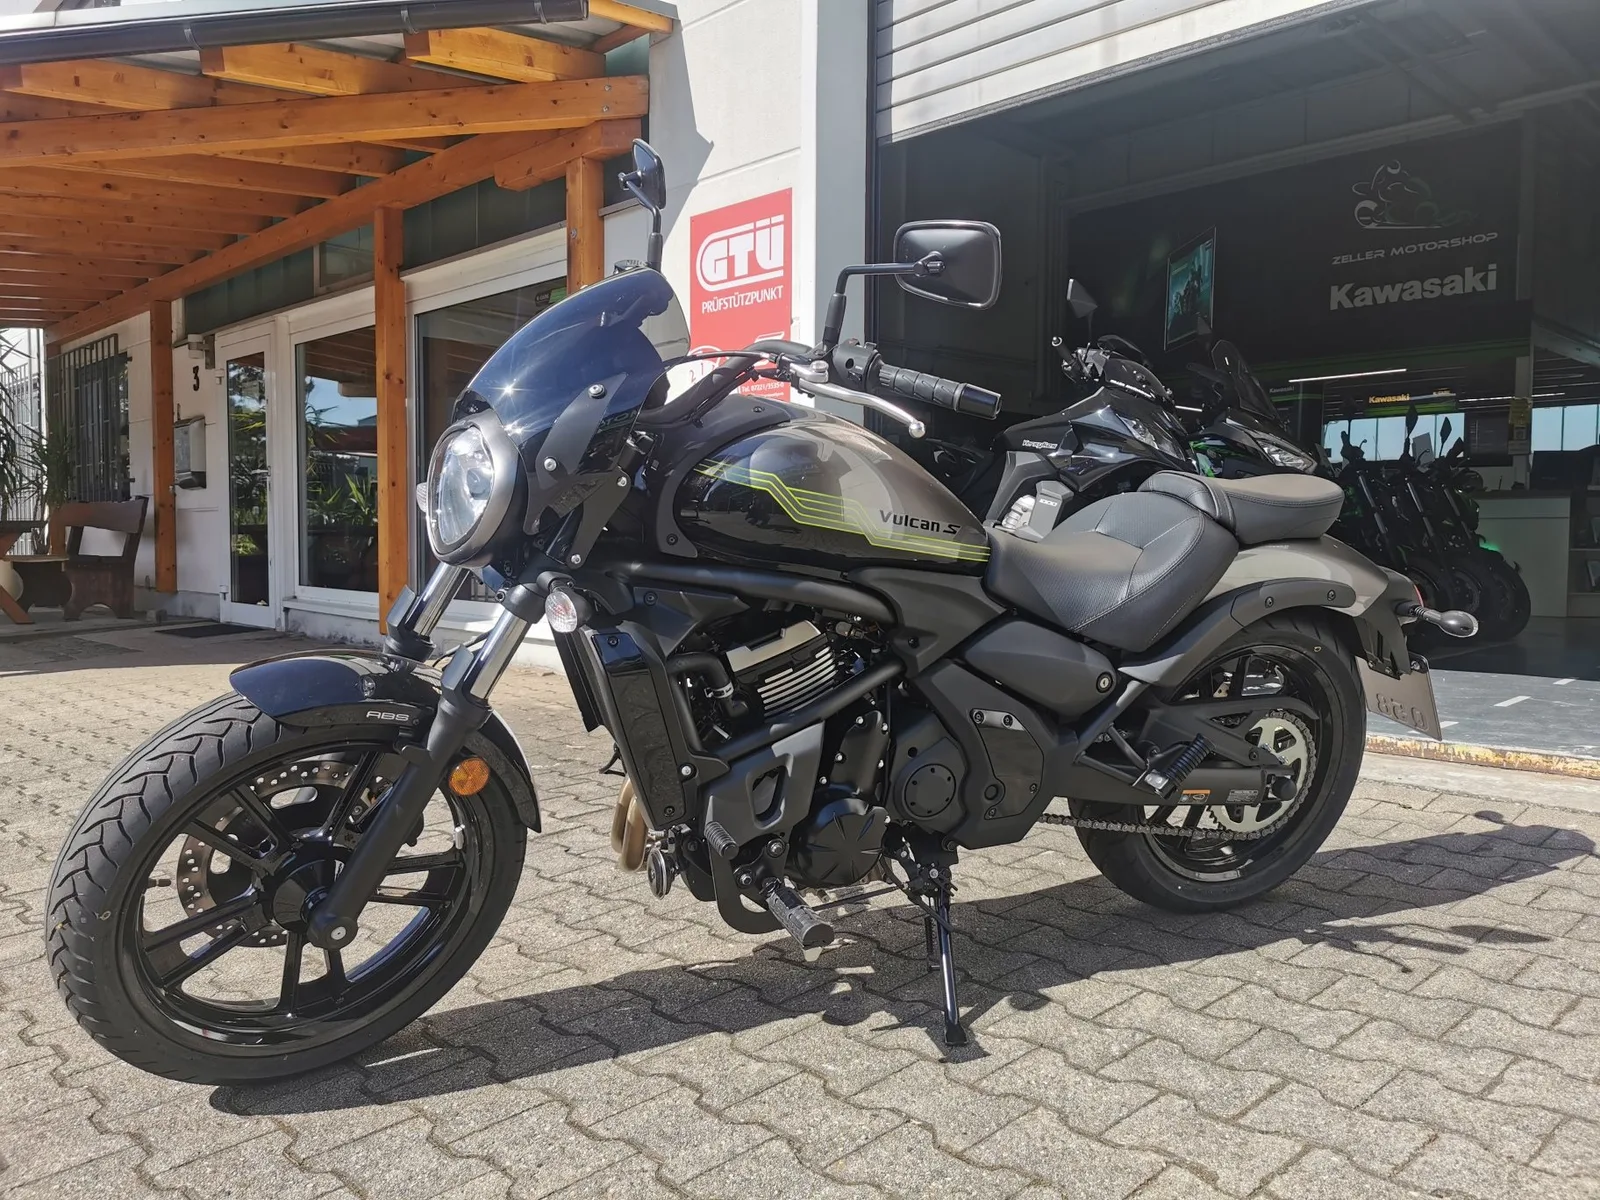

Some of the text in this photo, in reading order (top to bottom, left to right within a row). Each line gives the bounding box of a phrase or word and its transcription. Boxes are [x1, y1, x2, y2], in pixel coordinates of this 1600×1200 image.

[701, 214, 784, 284] GTÜ
[1332, 232, 1498, 265] ZELLER MOTORSHOP
[702, 285, 784, 314] PRÜFSTÜTZPUNKT
[1330, 263, 1497, 311] Kawasaki
[193, 365, 200, 391] 3
[1369, 393, 1410, 403] Kawasaki
[879, 509, 961, 535] Vulcan S
[366, 711, 410, 722] ABS
